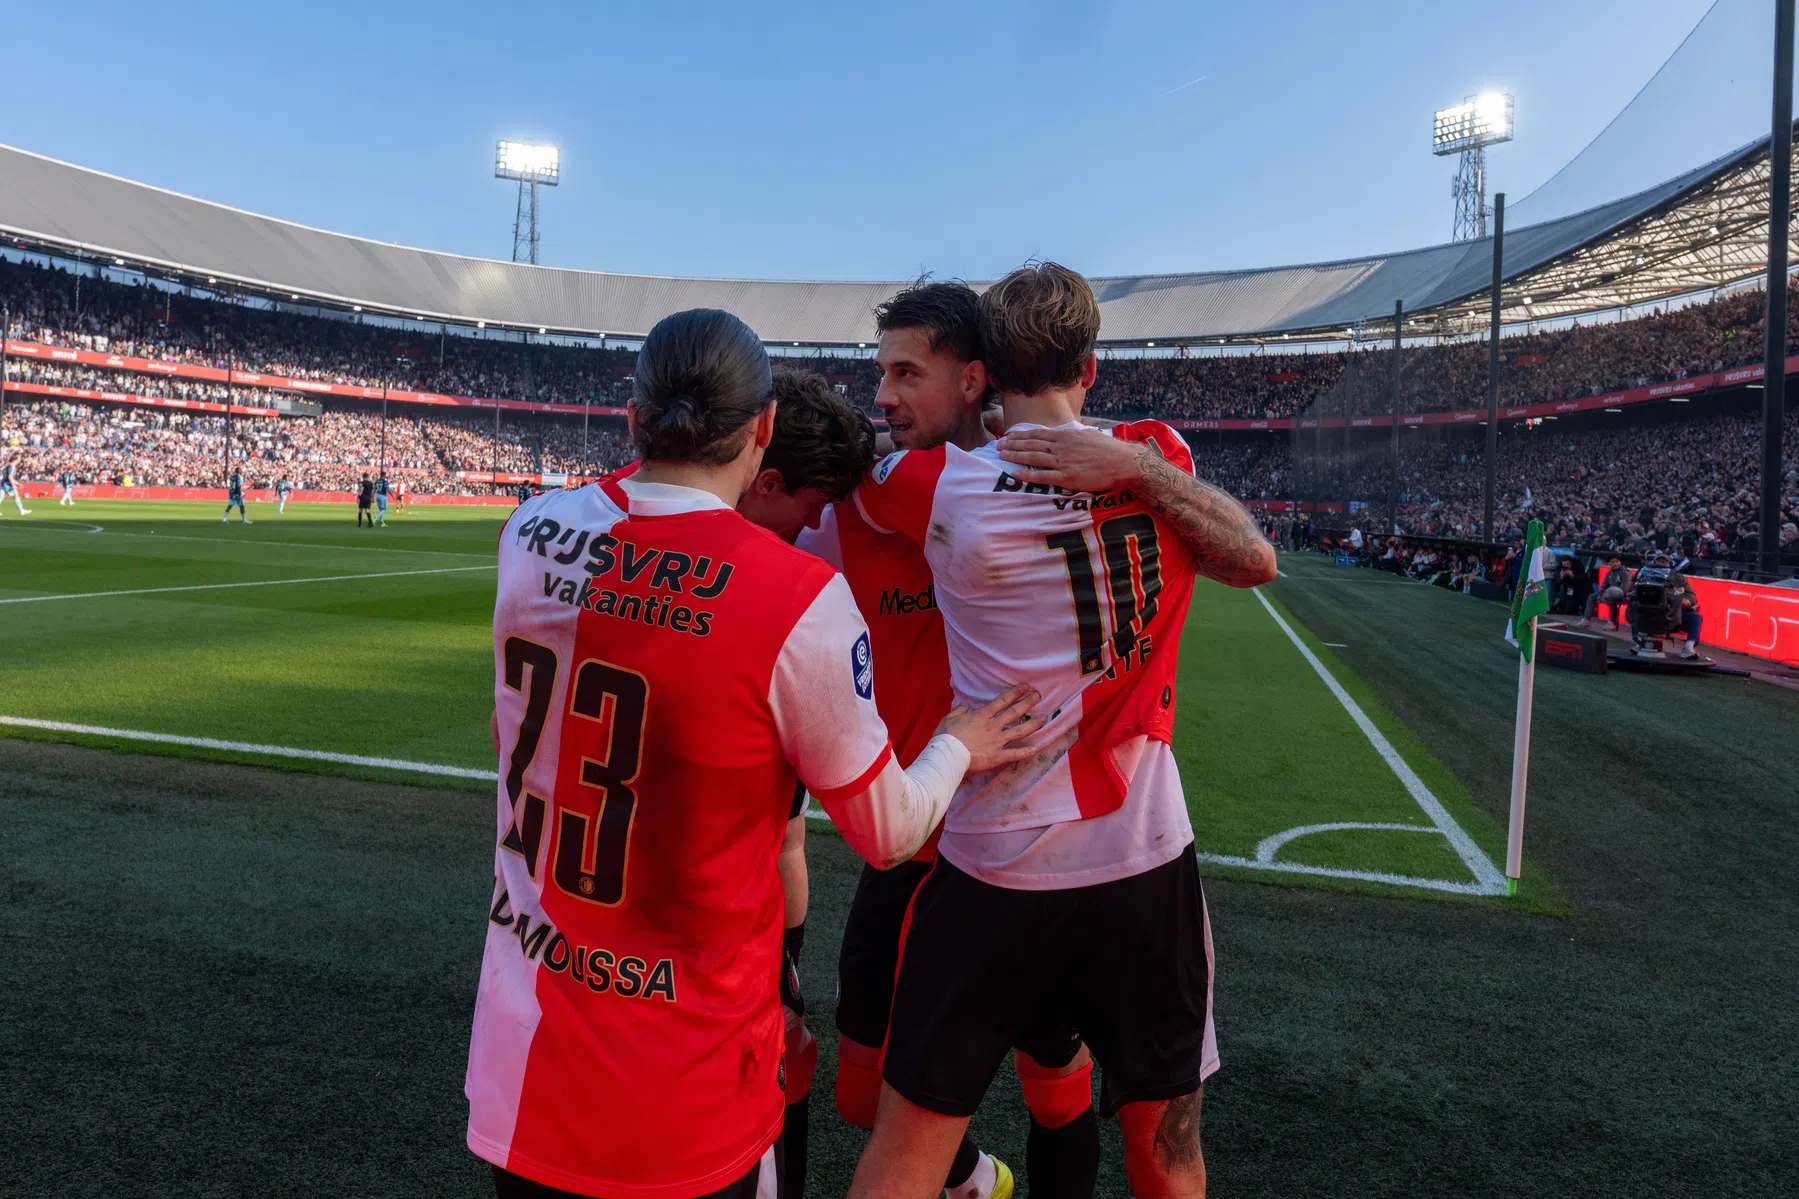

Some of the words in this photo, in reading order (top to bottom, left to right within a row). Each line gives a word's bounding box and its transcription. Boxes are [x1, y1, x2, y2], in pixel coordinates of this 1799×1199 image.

[544, 572, 714, 637] vakanties
[1044, 513, 1163, 678] 10
[499, 634, 649, 906] 23
